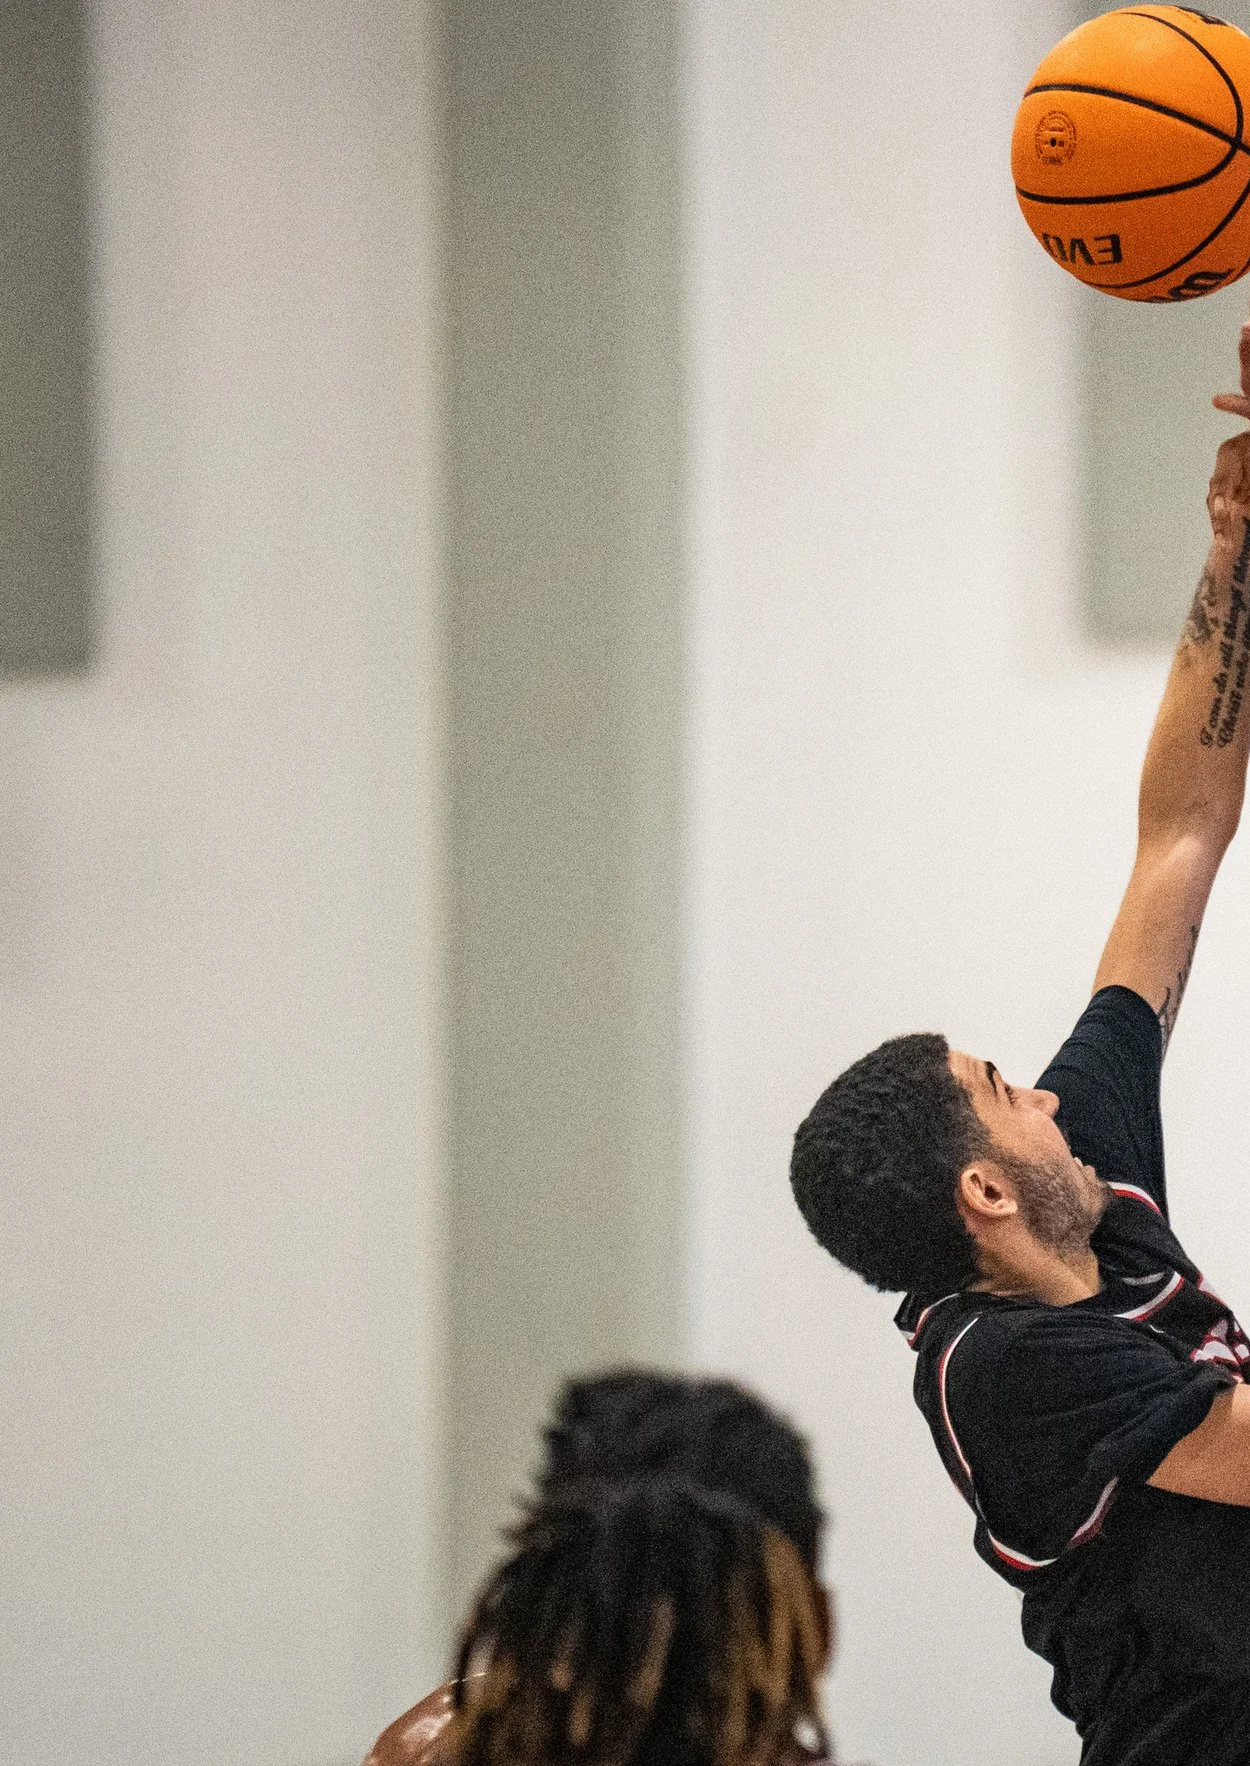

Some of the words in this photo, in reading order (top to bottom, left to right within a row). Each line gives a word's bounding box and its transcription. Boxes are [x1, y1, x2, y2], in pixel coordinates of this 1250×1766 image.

[1219, 641, 1234, 669] all
[1212, 672, 1228, 694] do
[1209, 697, 1222, 729] can
